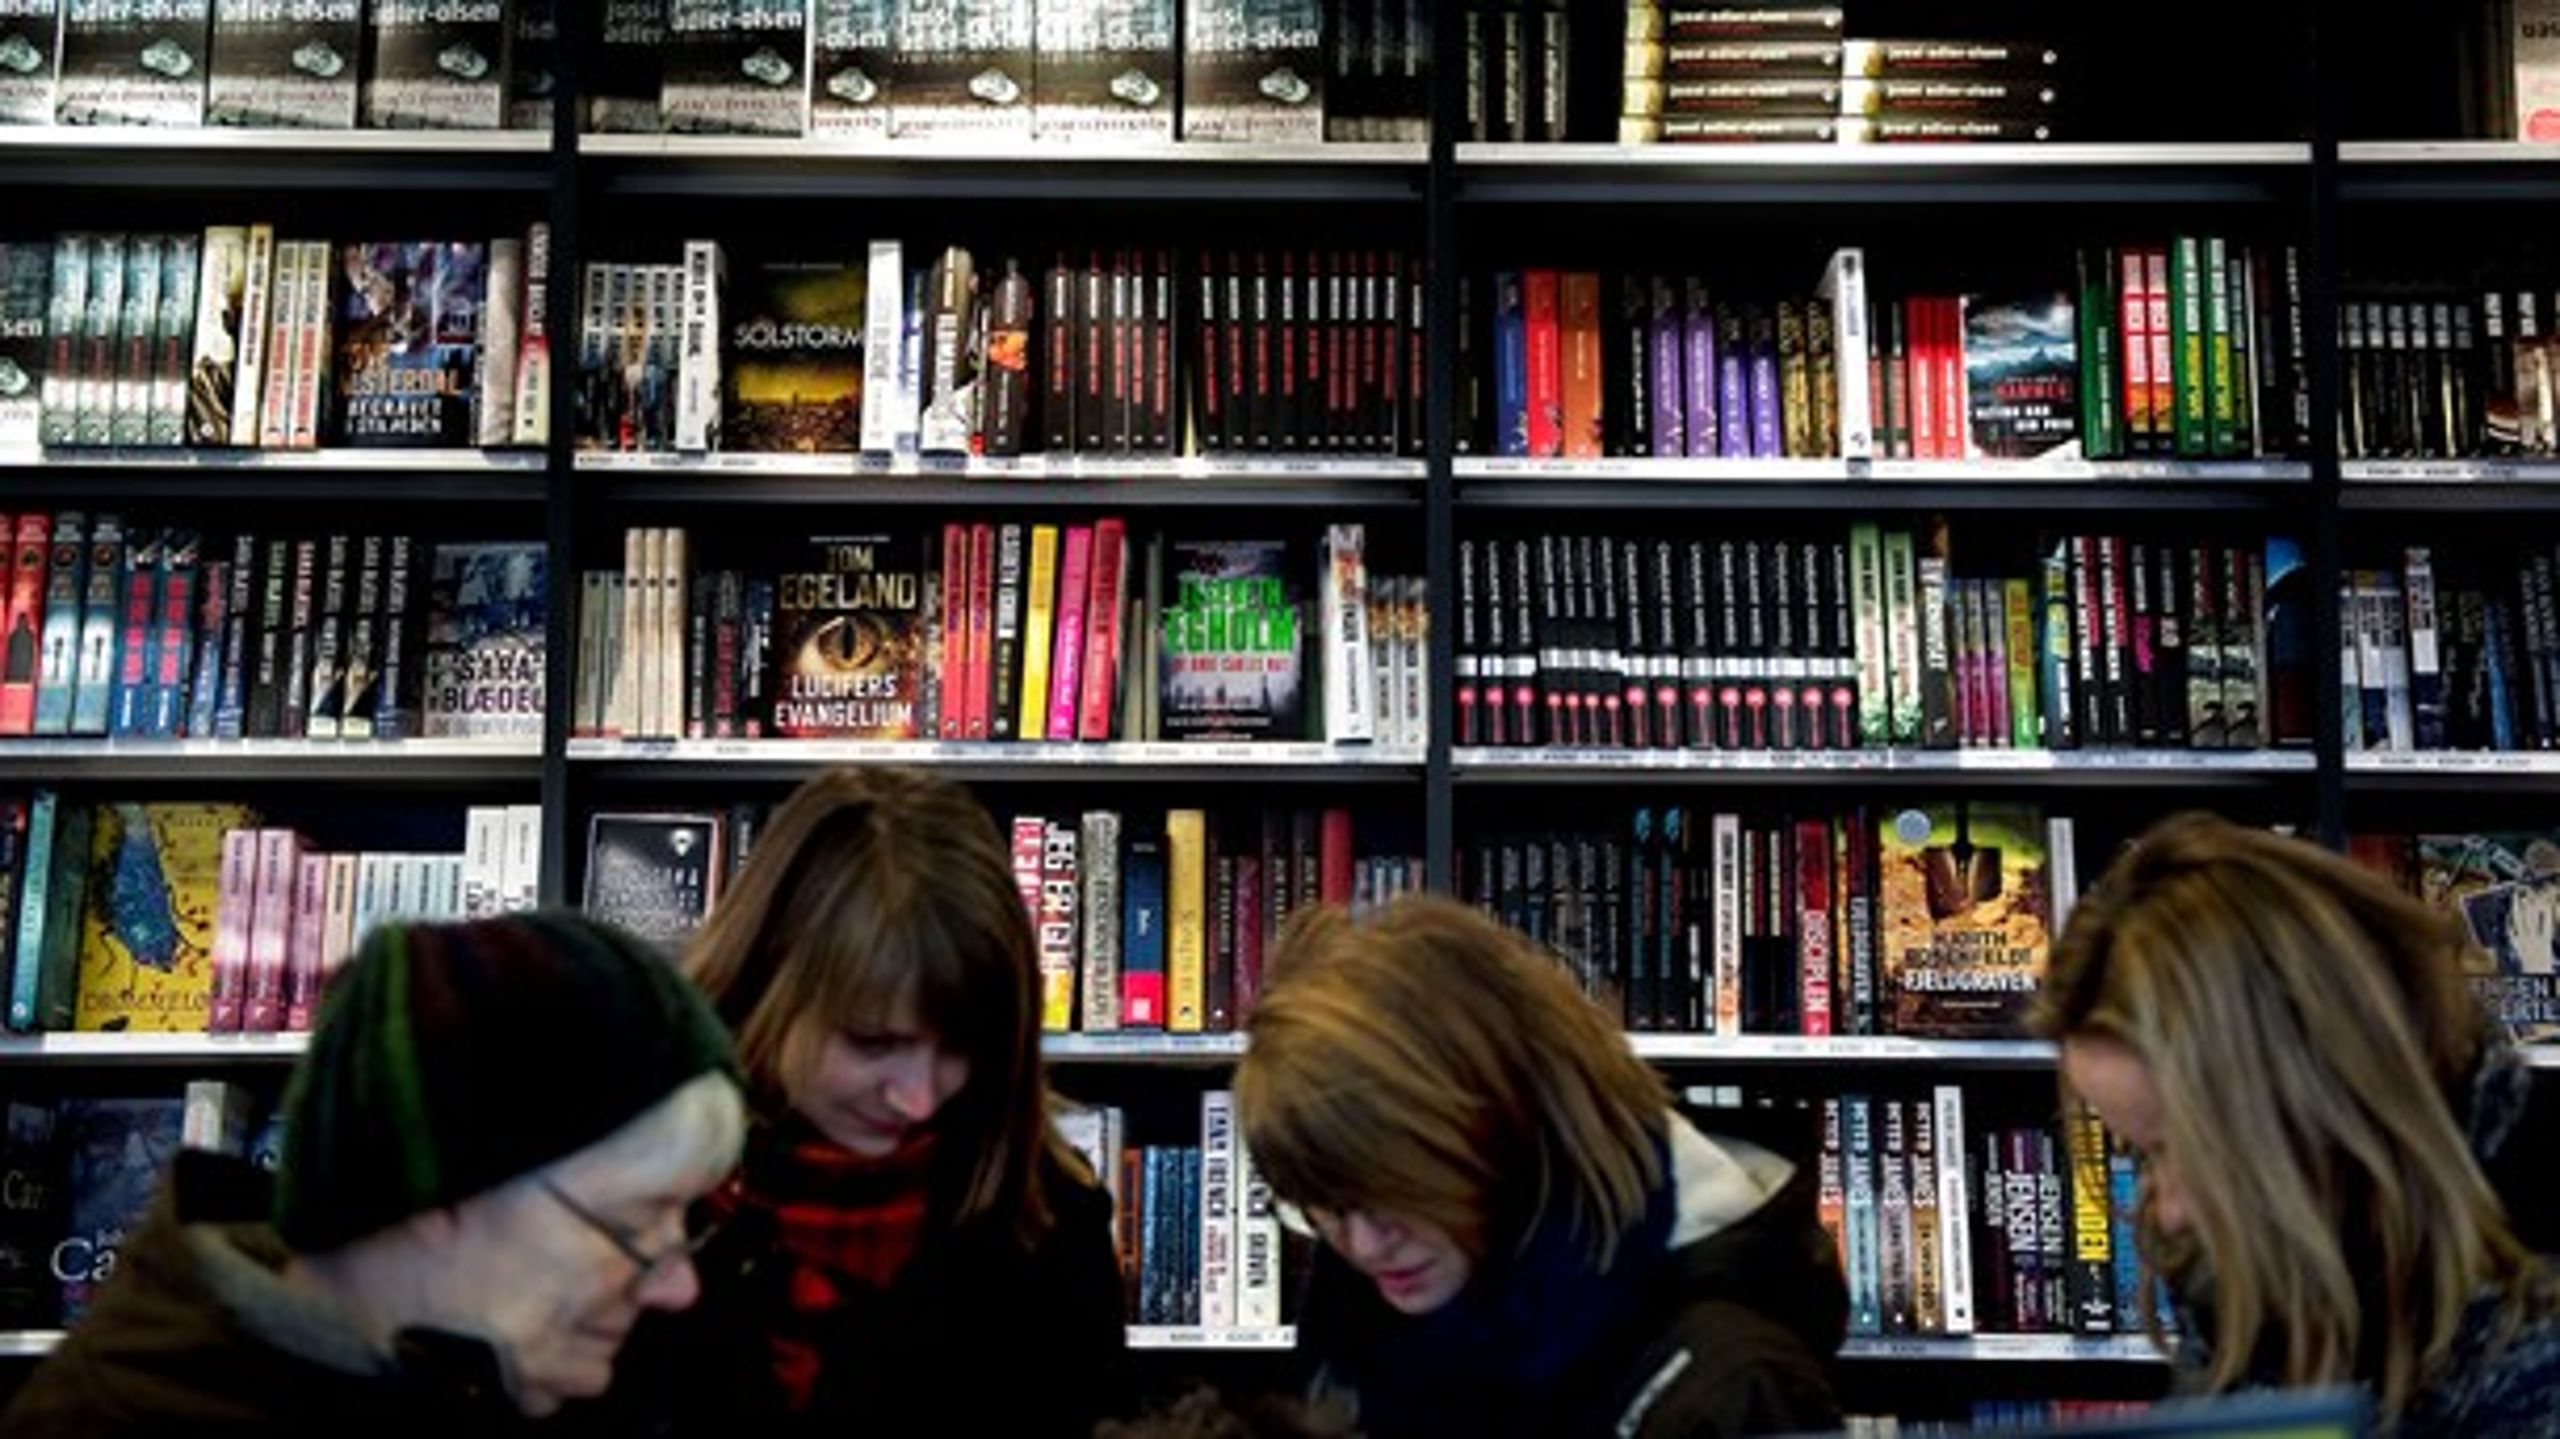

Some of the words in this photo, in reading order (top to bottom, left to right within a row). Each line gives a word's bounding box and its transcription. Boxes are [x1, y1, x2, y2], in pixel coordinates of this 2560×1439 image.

[827, 545, 875, 571] TOM
[779, 573, 916, 610] EGELAND
[460, 655, 532, 682] SARA
[791, 674, 897, 698] LUCIFERS
[774, 702, 912, 727] EVANGELIUM
[2004, 1169, 2038, 1251] JENSEN
